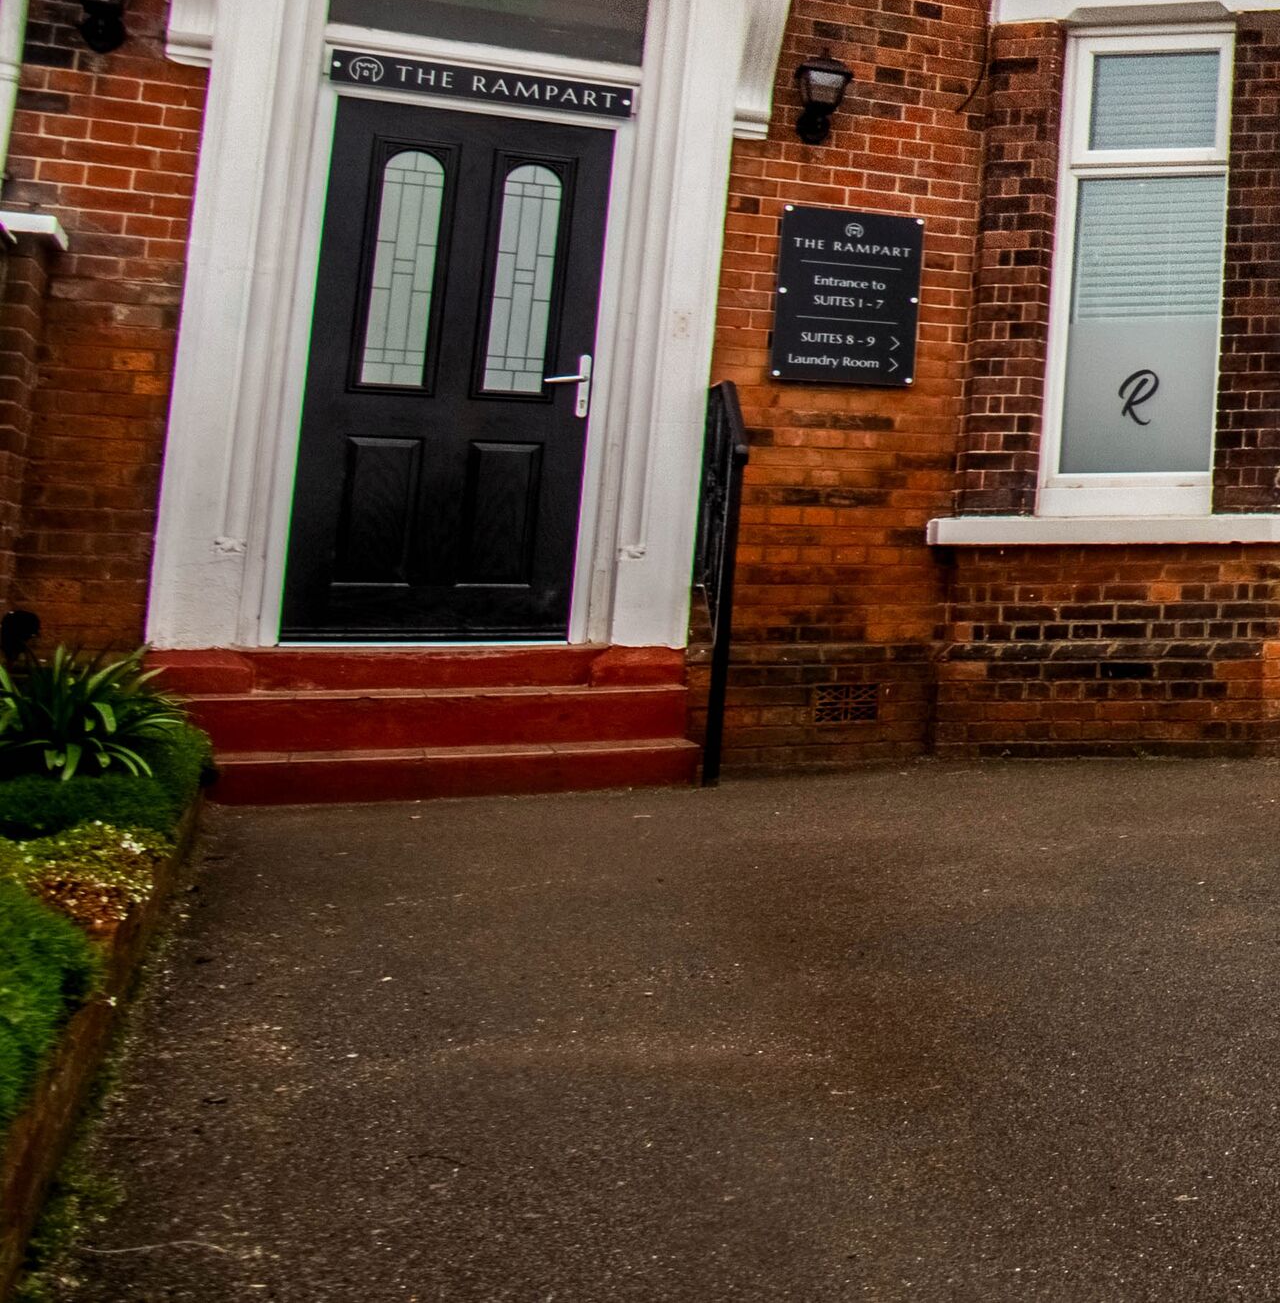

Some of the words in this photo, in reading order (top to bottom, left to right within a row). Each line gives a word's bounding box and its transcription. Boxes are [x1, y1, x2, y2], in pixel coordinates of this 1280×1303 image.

[396, 64, 454, 88] THE
[472, 75, 618, 108] RAMPART
[793, 237, 825, 250] THE
[833, 241, 912, 258] RAMPART
[814, 275, 869, 290] Entrance
[872, 280, 886, 290] to
[813, 295, 855, 308] SUITES
[875, 299, 884, 309] 7
[801, 331, 843, 344] SUITES
[846, 334, 854, 345] 8
[867, 336, 875, 347] 9
[788, 353, 839, 369] Laundry
[842, 357, 880, 368] Room
[1117, 368, 1160, 426] R
